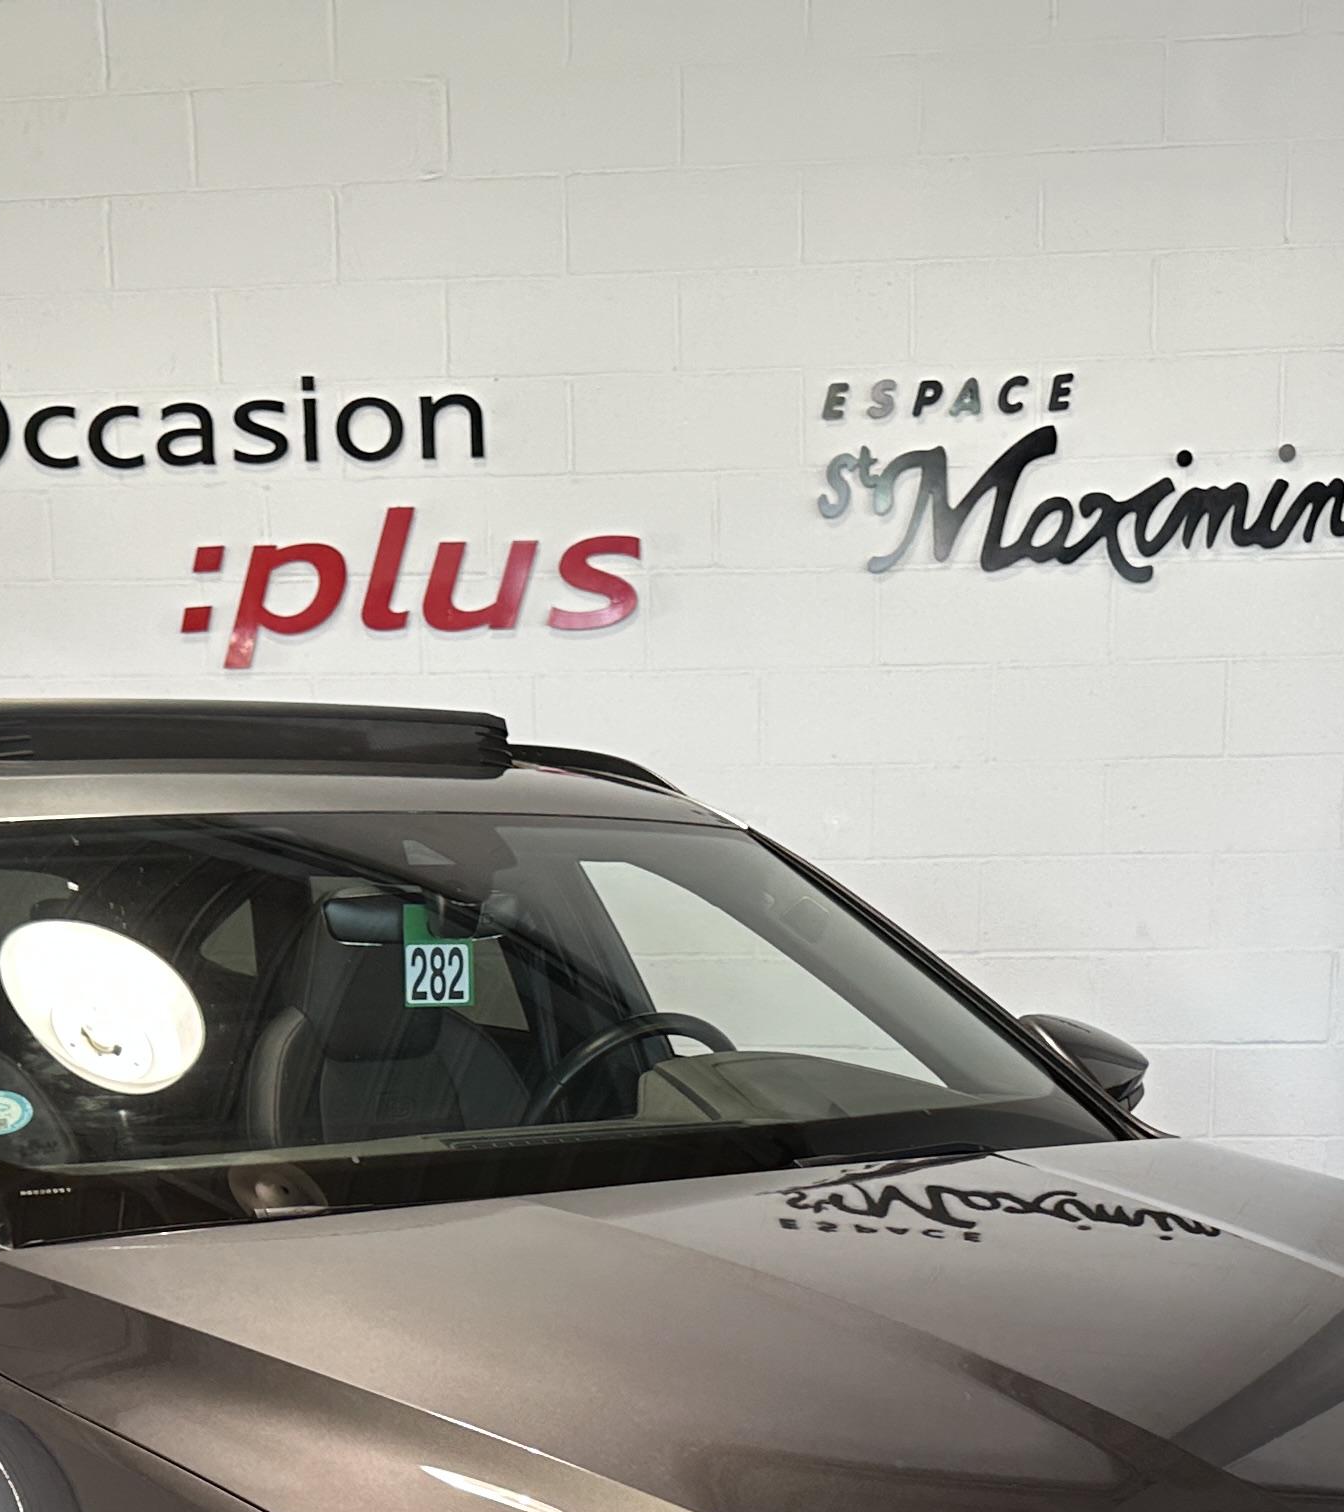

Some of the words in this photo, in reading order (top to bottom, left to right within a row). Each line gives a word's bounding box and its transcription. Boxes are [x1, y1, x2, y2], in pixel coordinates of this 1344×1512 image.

[821, 373, 1074, 420] ESPACE
[818, 445, 879, 519] St
[181, 506, 642, 669] :plus
[411, 946, 464, 1001] 282
